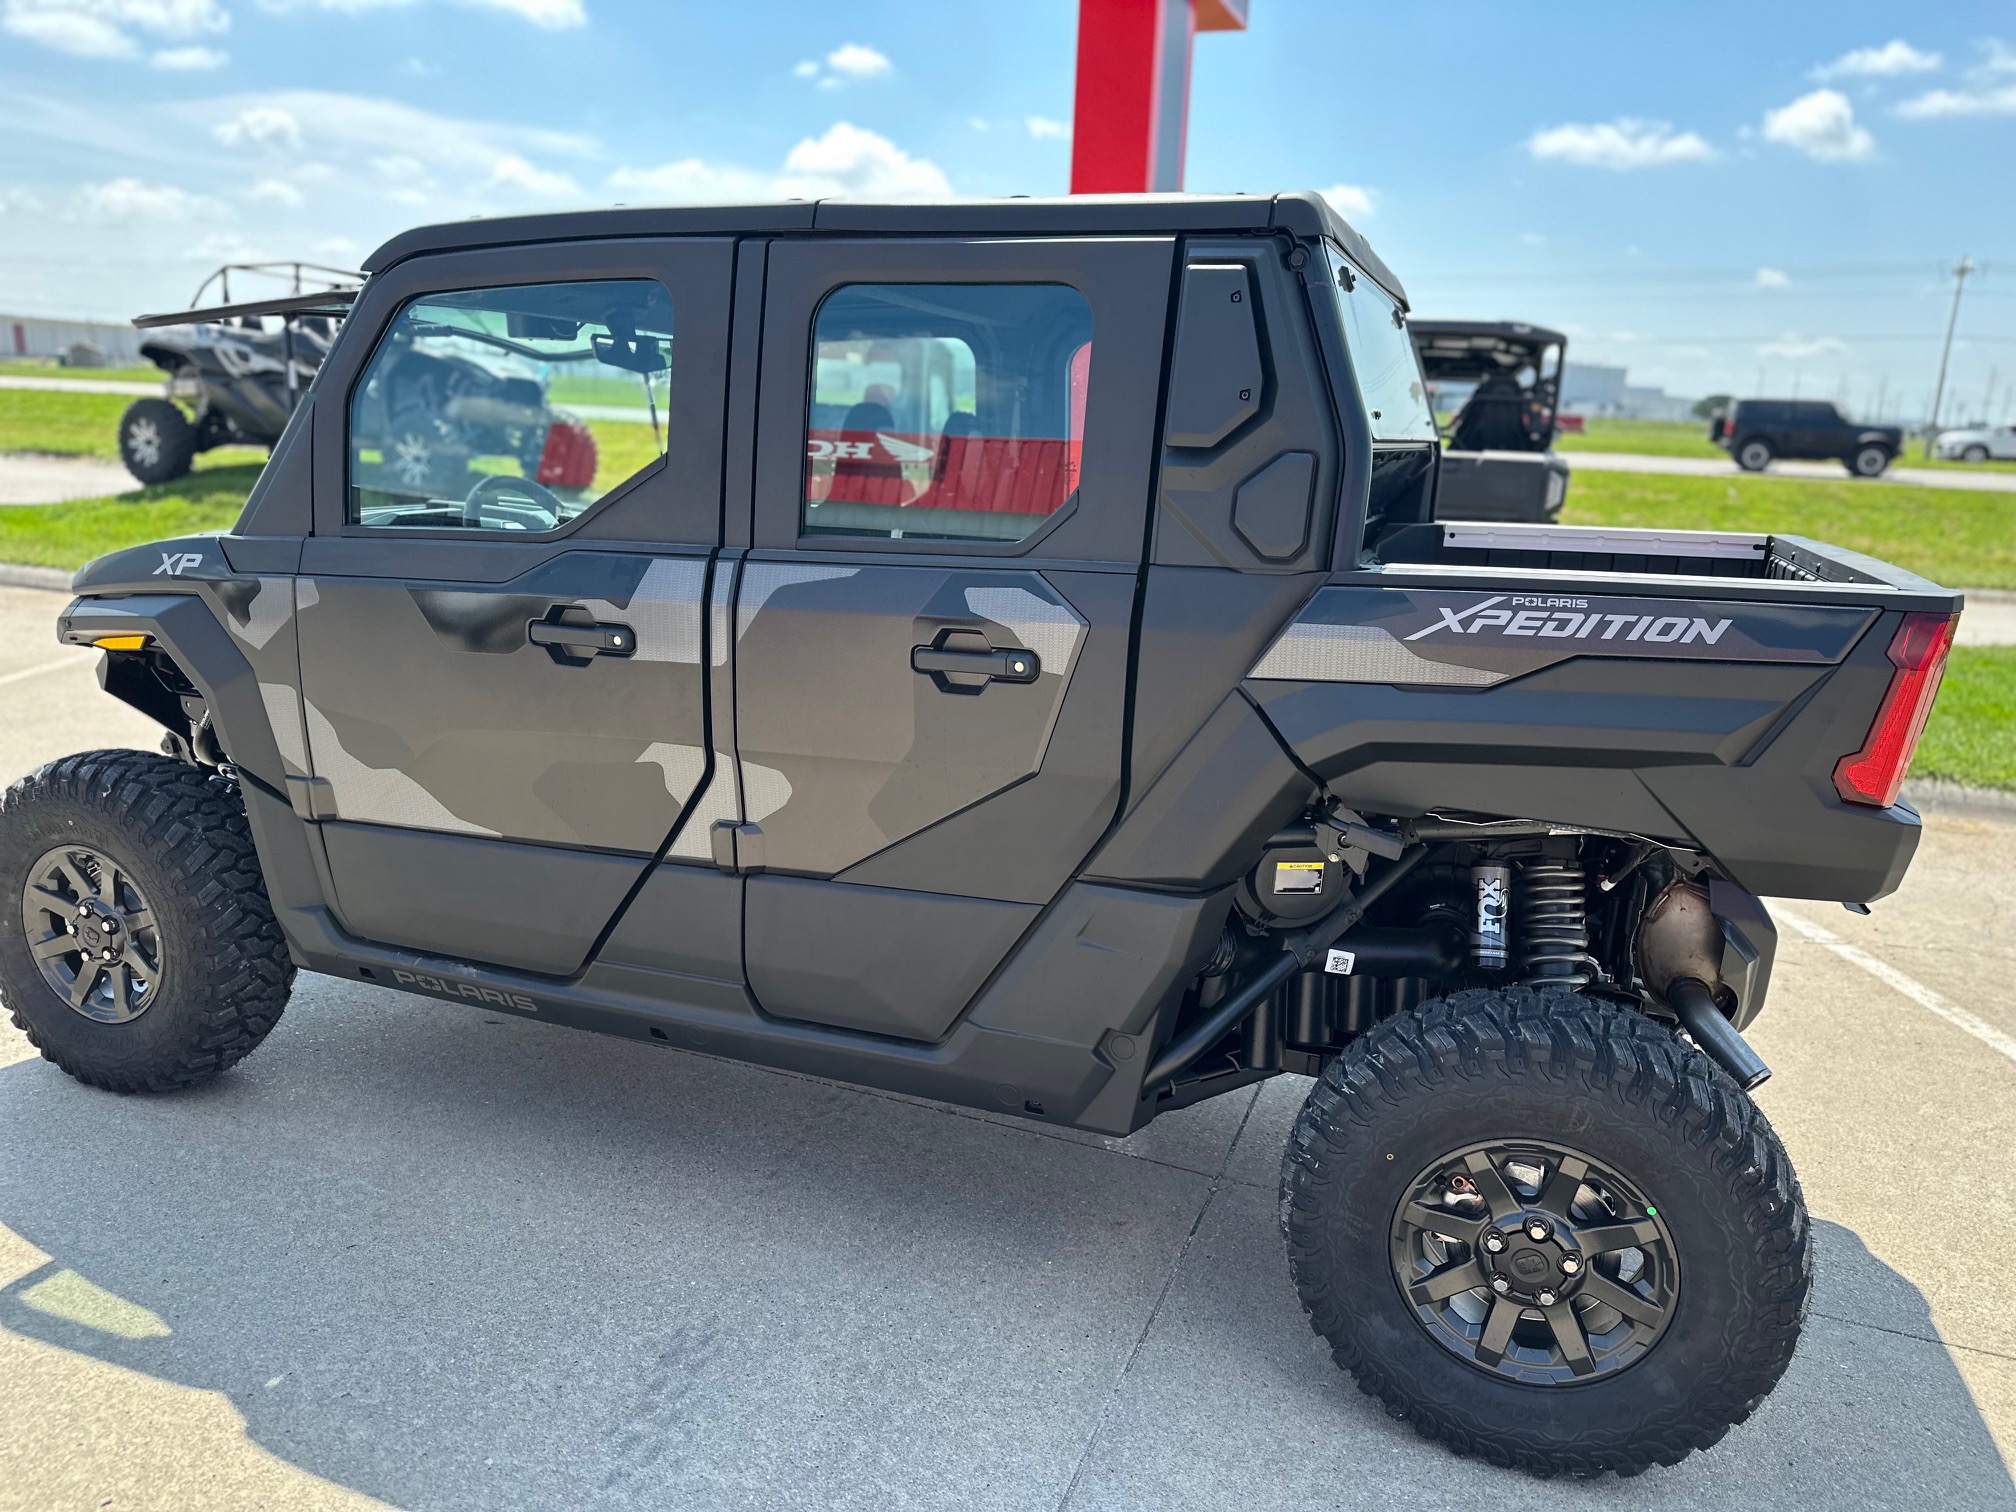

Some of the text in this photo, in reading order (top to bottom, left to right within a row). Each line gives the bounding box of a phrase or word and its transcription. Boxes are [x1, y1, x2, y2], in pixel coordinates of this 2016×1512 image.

[152, 553, 203, 575] XP
[1403, 596, 1733, 645] XPEDITION
[1512, 596, 1588, 609] POLARIS
[1478, 878, 1506, 934] FOX
[392, 969, 538, 1012] POLARIS
